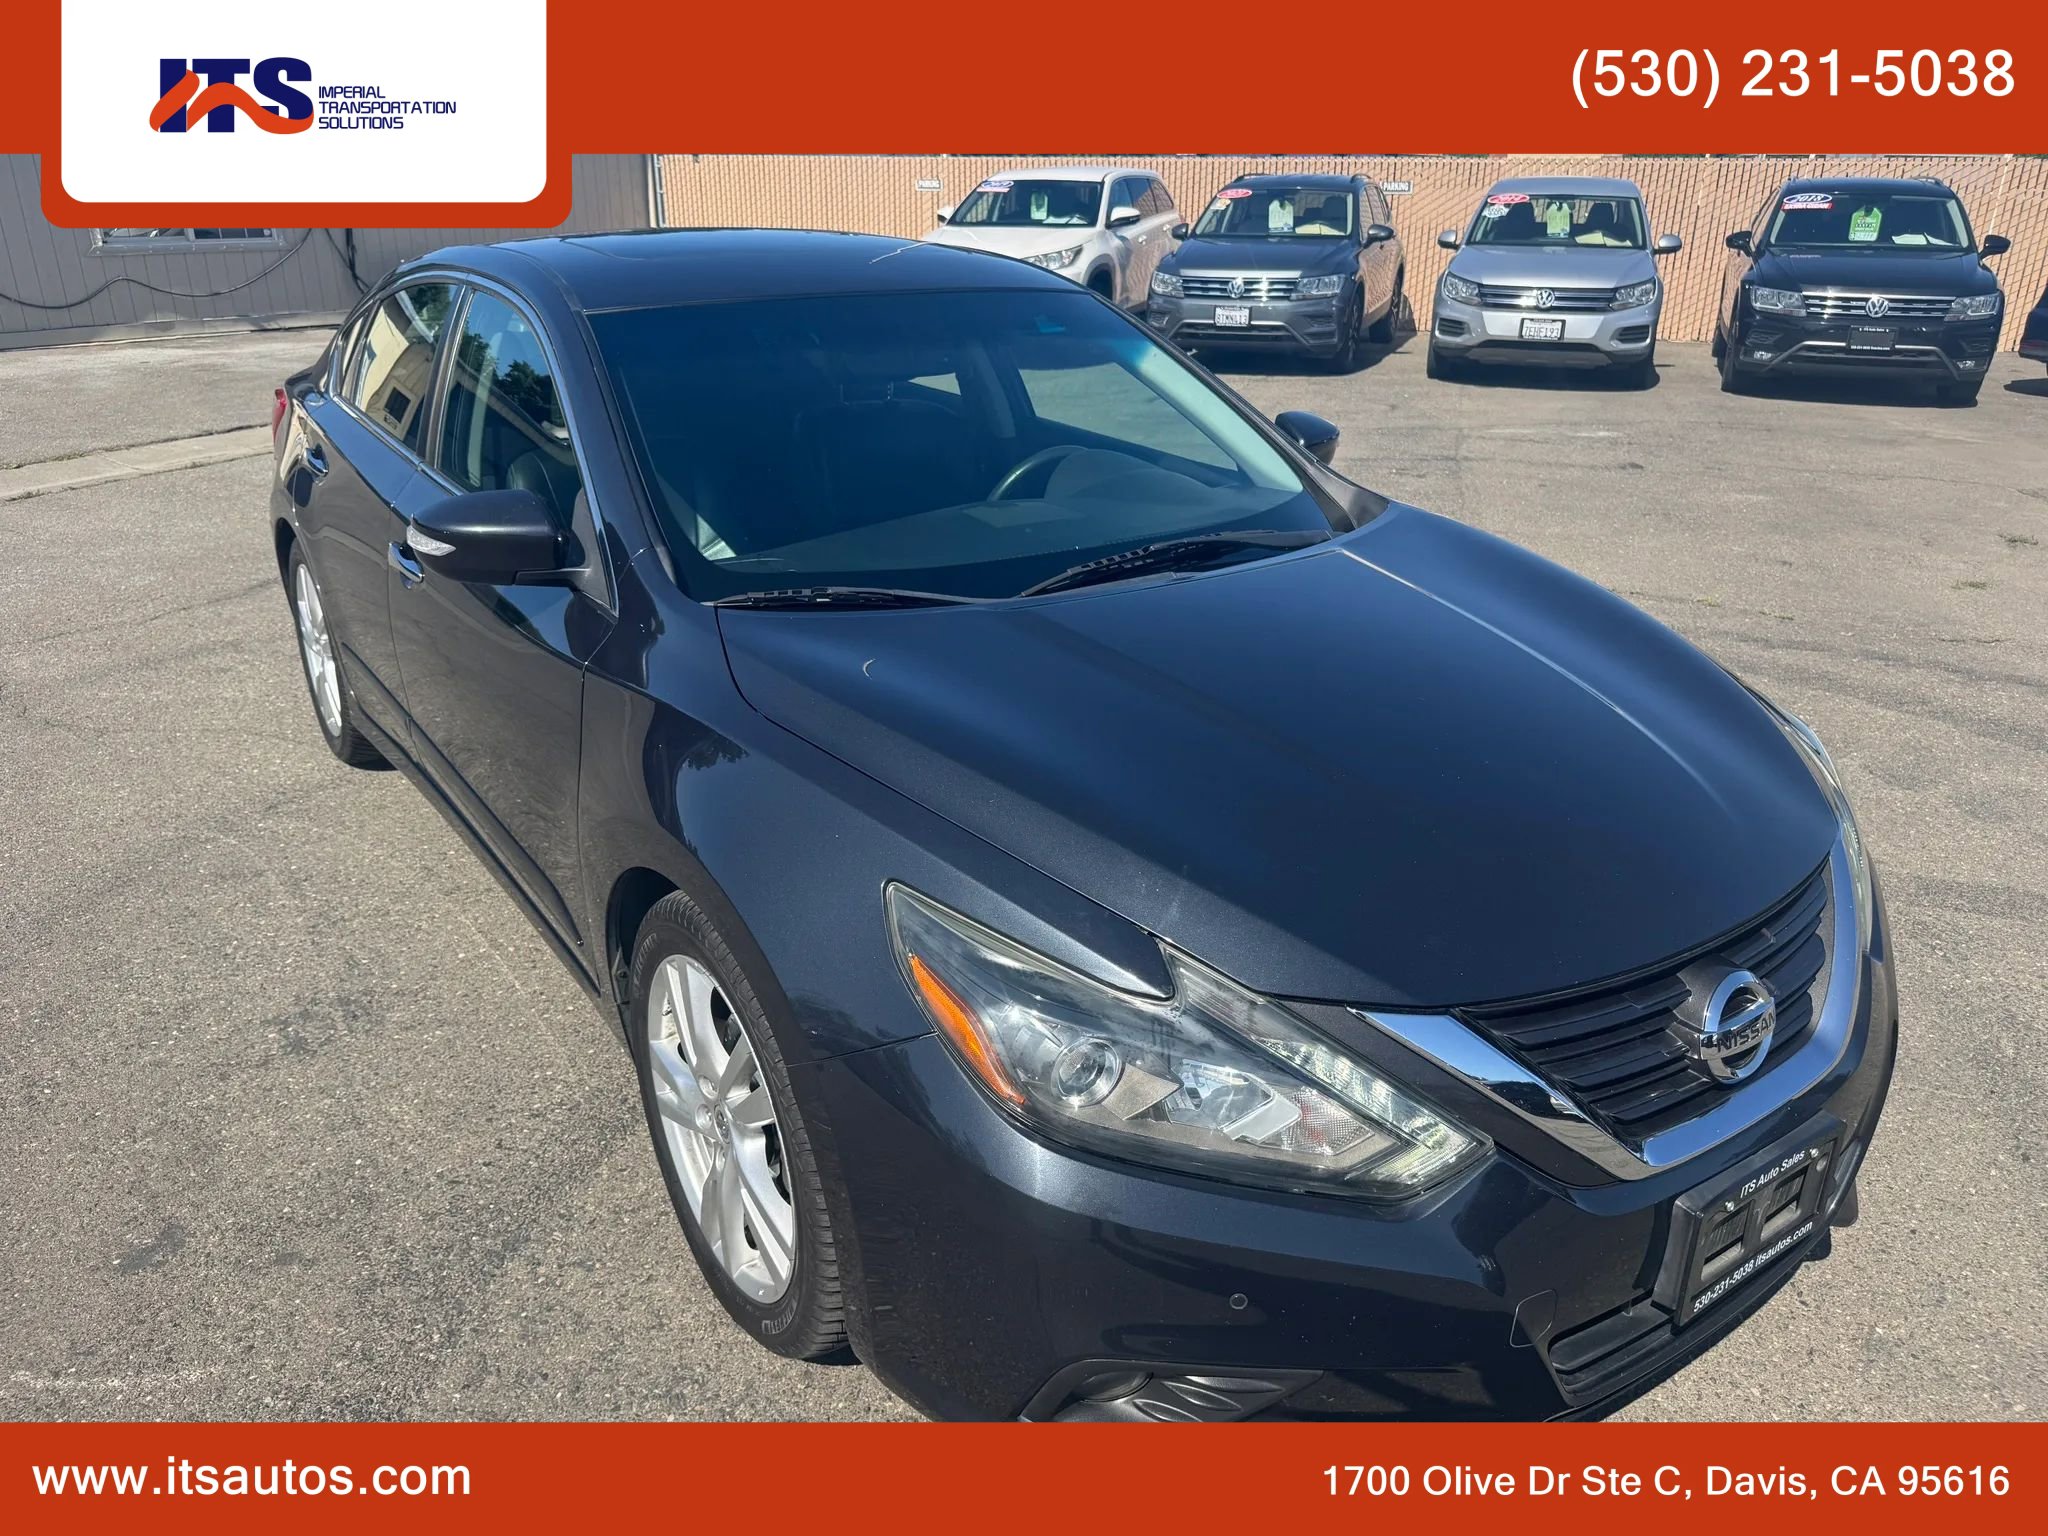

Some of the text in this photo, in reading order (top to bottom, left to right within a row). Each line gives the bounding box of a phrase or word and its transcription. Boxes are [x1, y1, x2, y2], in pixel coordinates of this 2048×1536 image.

[1383, 182, 1409, 191] PARKING
[1717, 1012, 1775, 1052] NISSAN
[1740, 1150, 1806, 1199] ITS Auto Sales
[1693, 1221, 1814, 1312] 530-231-5038 itsautos.com
